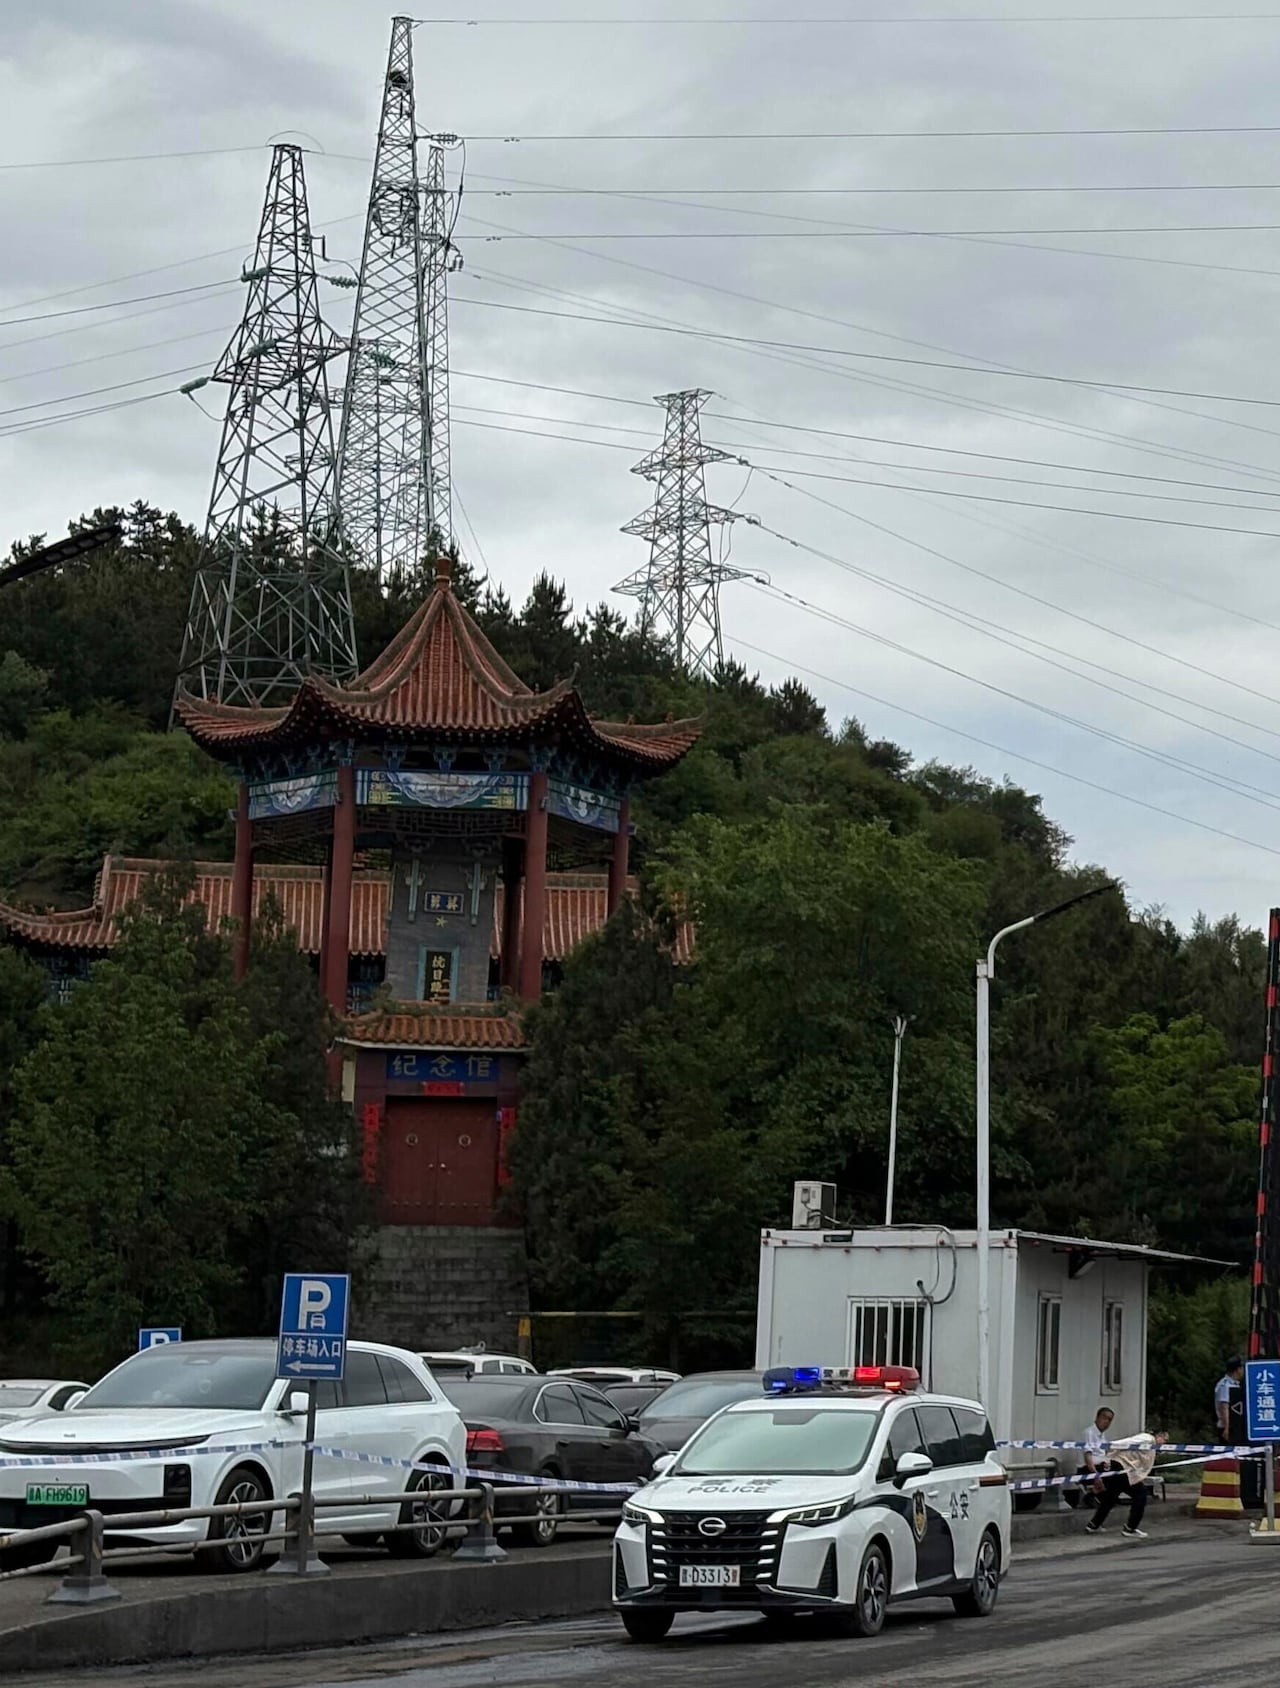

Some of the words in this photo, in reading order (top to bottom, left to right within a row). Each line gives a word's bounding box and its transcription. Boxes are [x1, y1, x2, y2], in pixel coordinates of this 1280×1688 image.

[392, 1055, 493, 1077] 纪念馆
[298, 1280, 332, 1330] P
[282, 1337, 341, 1358] 停车场入口
[1256, 1369, 1276, 1422] 小车通道
[687, 1486, 769, 1494] POLICE
[949, 1490, 969, 1519] 公安
